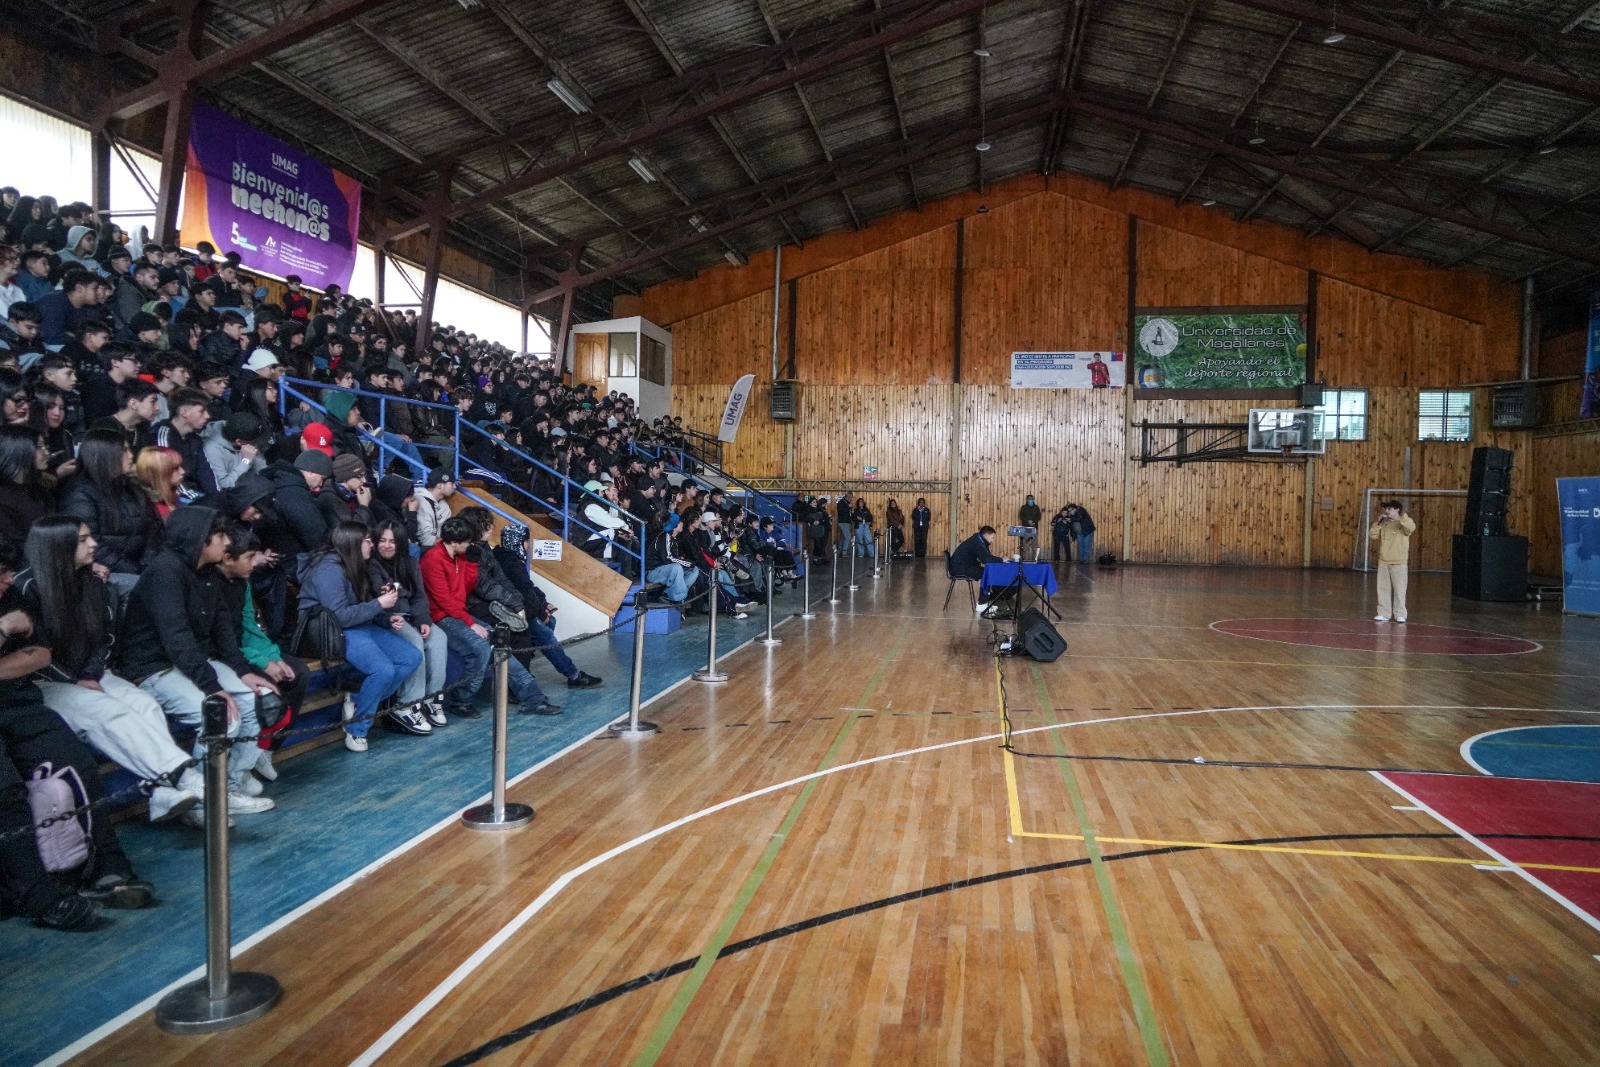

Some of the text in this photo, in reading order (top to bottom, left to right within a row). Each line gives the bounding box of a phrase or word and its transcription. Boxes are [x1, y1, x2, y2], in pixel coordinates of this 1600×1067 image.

[272, 152, 298, 175] UMAG
[232, 161, 329, 220] Bienvenid@s
[230, 222, 240, 245] 5
[1182, 325, 1297, 337] Universidad de
[1197, 338, 1285, 350] Magallanes
[1199, 356, 1280, 368] Apoyando el
[1184, 368, 1295, 380] deporte regional
[725, 393, 742, 426] UMAG
